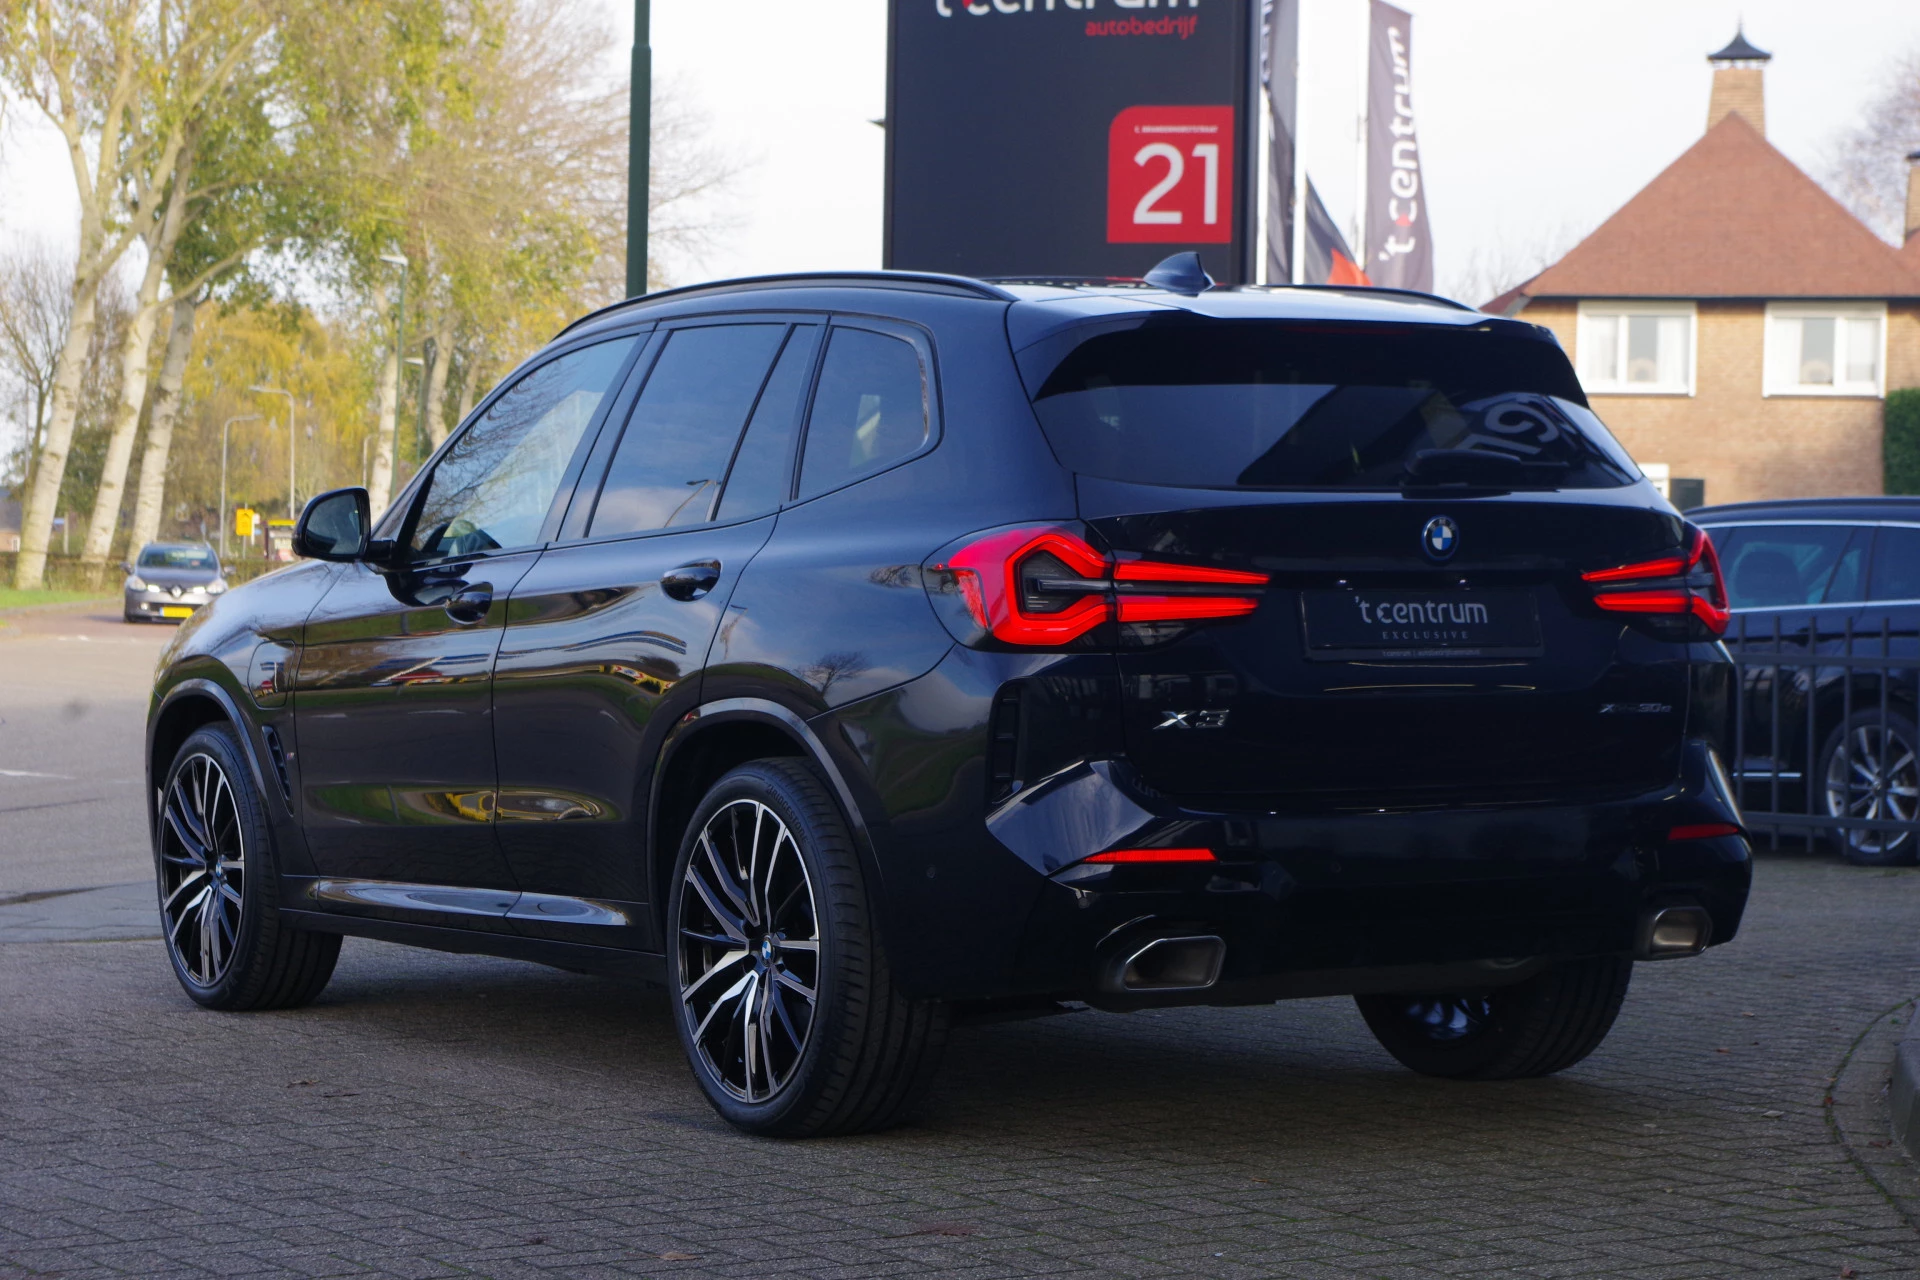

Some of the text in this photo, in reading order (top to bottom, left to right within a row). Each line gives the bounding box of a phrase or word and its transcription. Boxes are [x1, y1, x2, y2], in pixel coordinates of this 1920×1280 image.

[1085, 15, 1198, 40] autobedrijf
[1387, 26, 1418, 226] centrum
[1133, 142, 1218, 224] 21
[1376, 600, 1488, 624] centrum
[1382, 631, 1469, 640] EXCLUSIVE
[1152, 709, 1230, 730] X3
